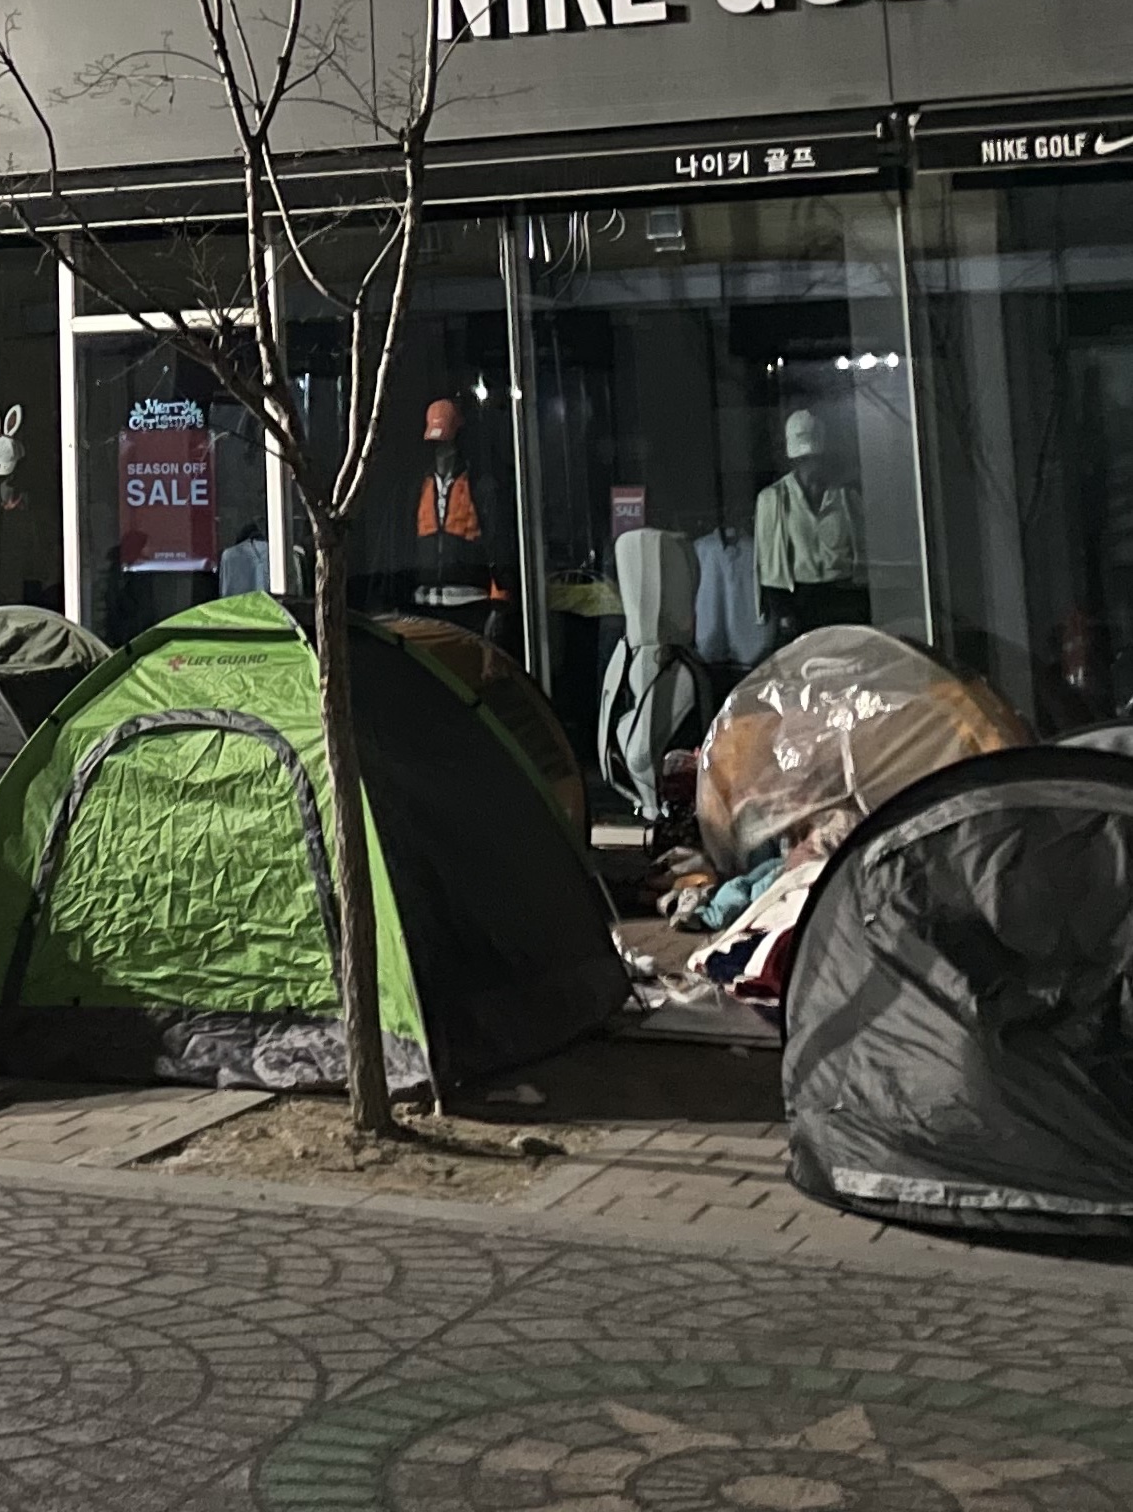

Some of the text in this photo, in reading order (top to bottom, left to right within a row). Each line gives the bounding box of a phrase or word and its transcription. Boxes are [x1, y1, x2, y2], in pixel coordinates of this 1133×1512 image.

[675, 146, 816, 179] 나이키 골프
[981, 131, 1088, 165] NIKE GOLF
[127, 461, 207, 475] SEASON OFF
[127, 478, 209, 507] SALE
[187, 653, 268, 667] LIFE GUARD
